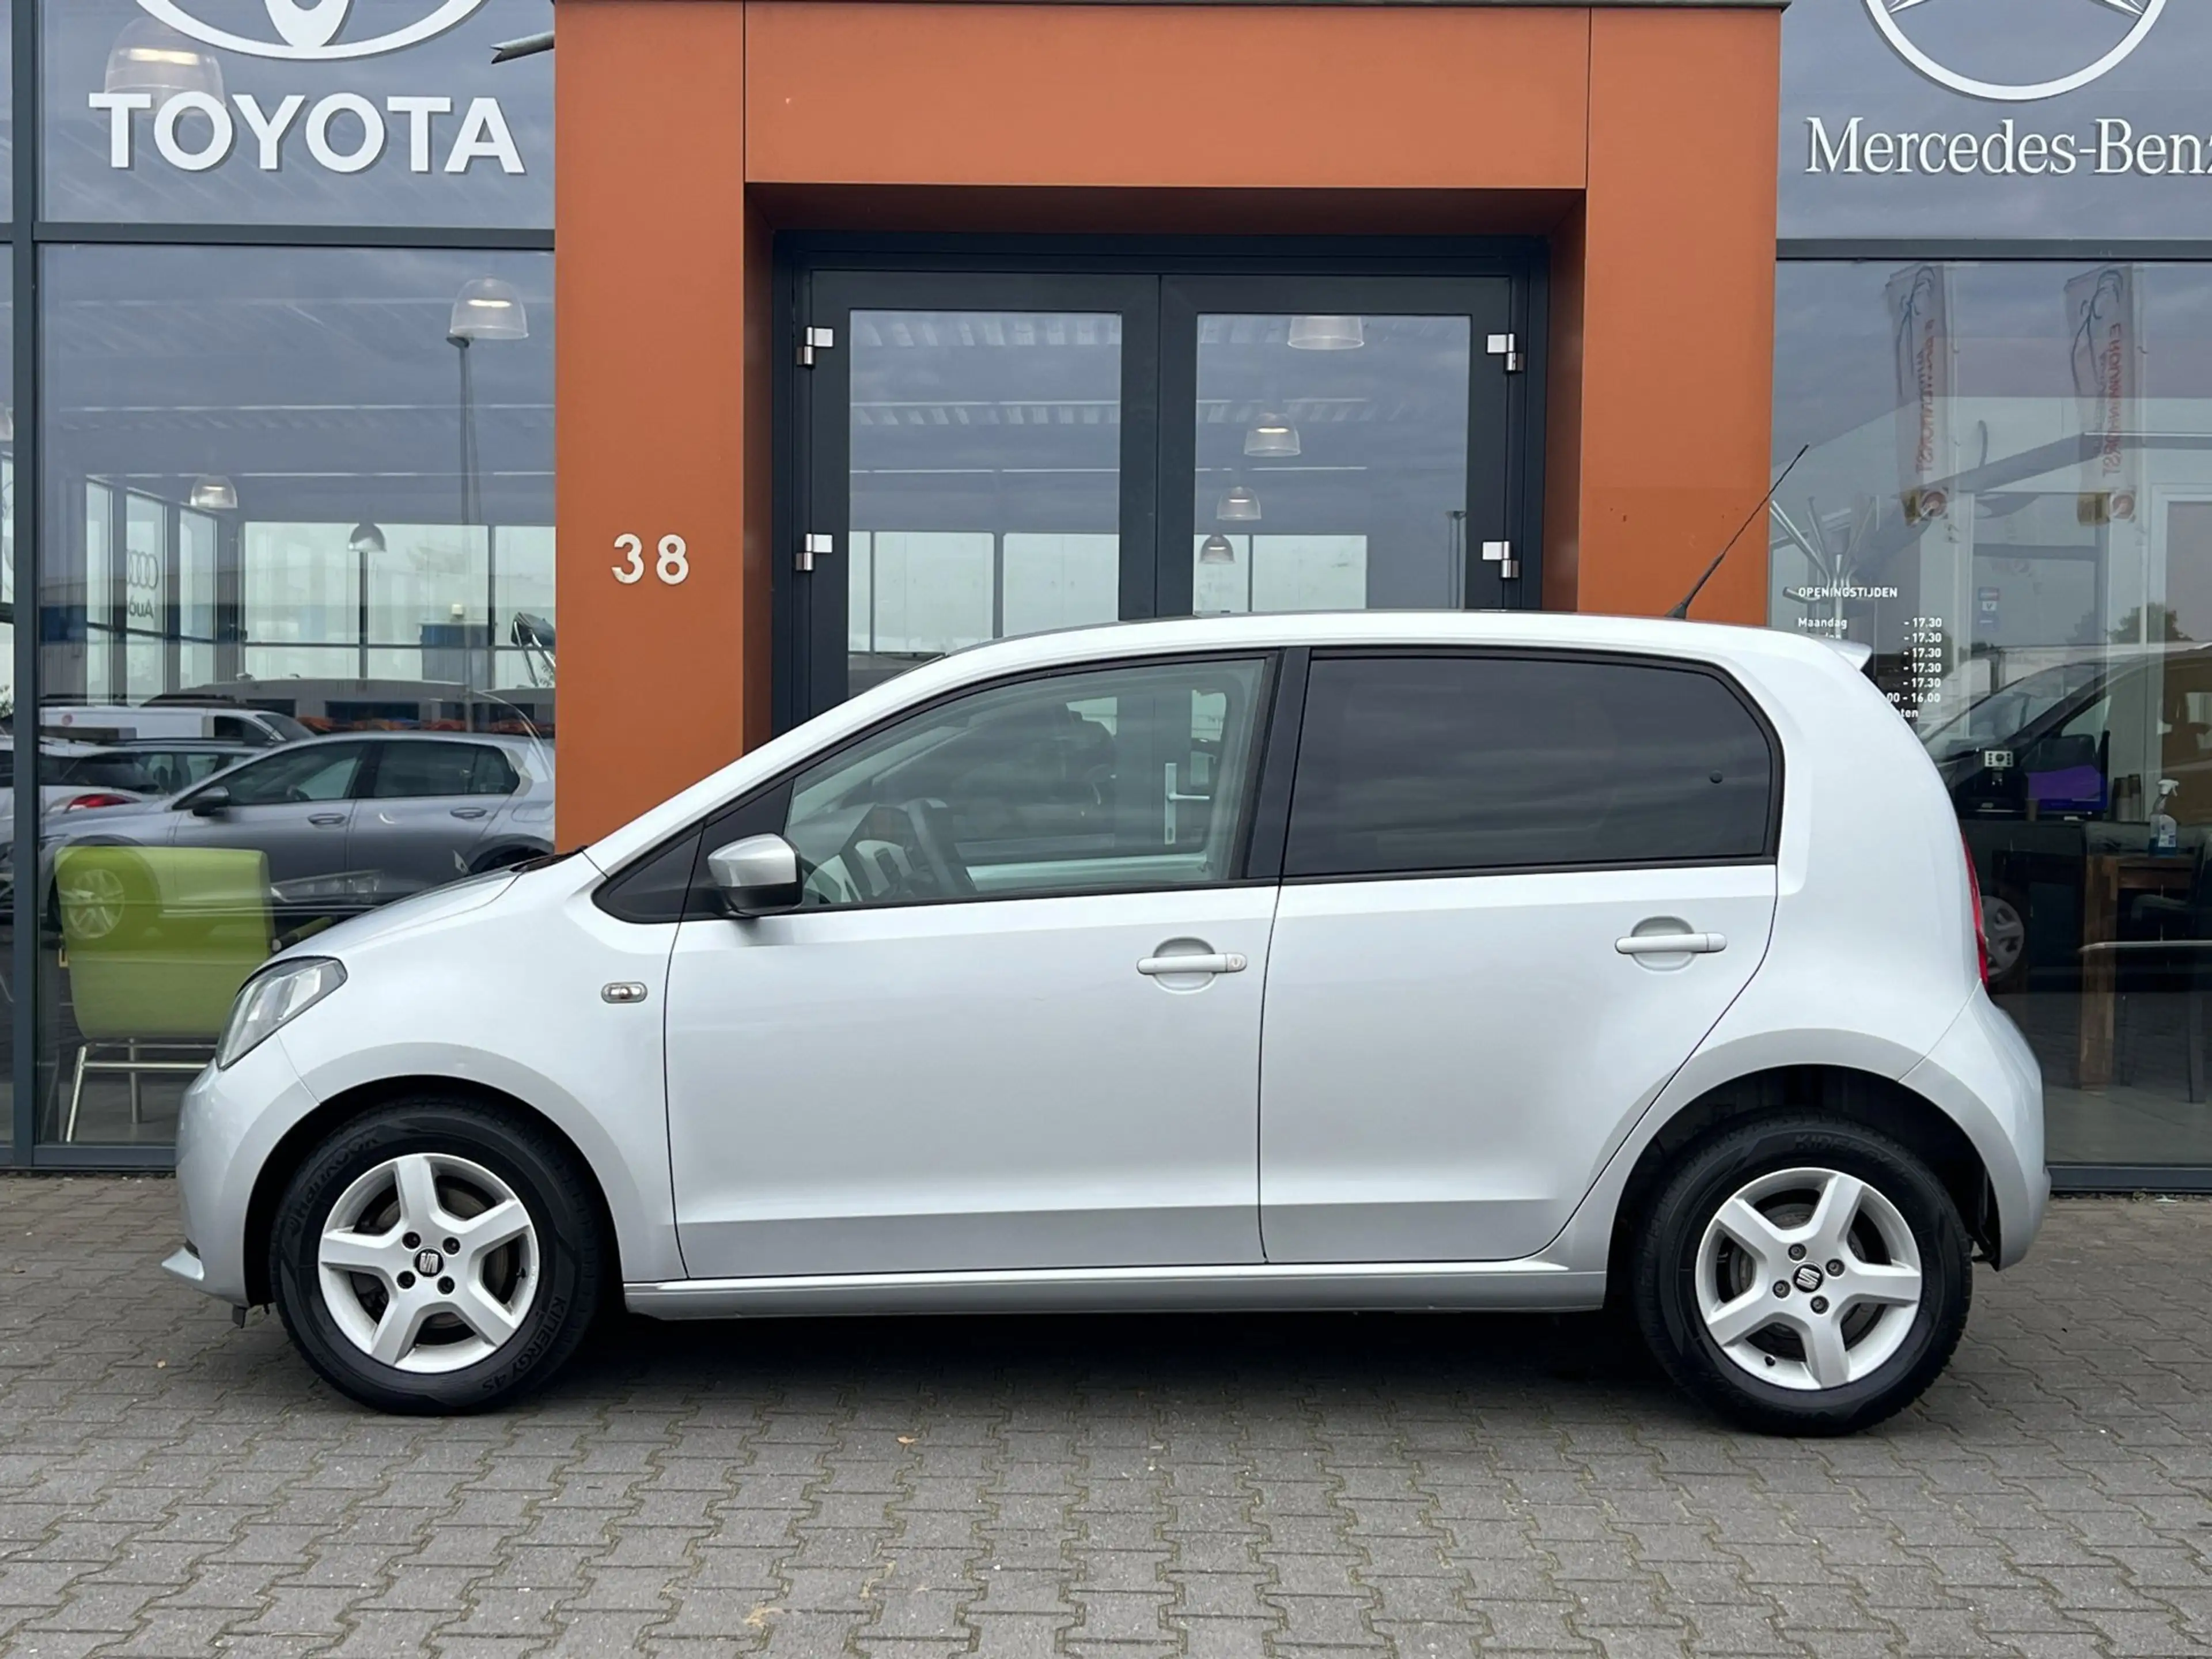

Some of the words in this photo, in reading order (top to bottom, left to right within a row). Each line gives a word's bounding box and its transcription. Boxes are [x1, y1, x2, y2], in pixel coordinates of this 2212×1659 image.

[89, 92, 525, 174] TOYOTA
[1806, 117, 2212, 174] Mercedes-Ben
[611, 533, 690, 585] 38
[1798, 587, 1897, 598] OPENINGSTIJDEN
[1798, 617, 1847, 630] Maandag
[1912, 618, 1942, 628] 17.30
[1912, 632, 1942, 643] 17.30
[1912, 647, 1942, 658] 17.30
[1912, 662, 1942, 673] 17.30
[1911, 677, 1941, 688] 17.30
[1911, 692, 1941, 703] 16.00
